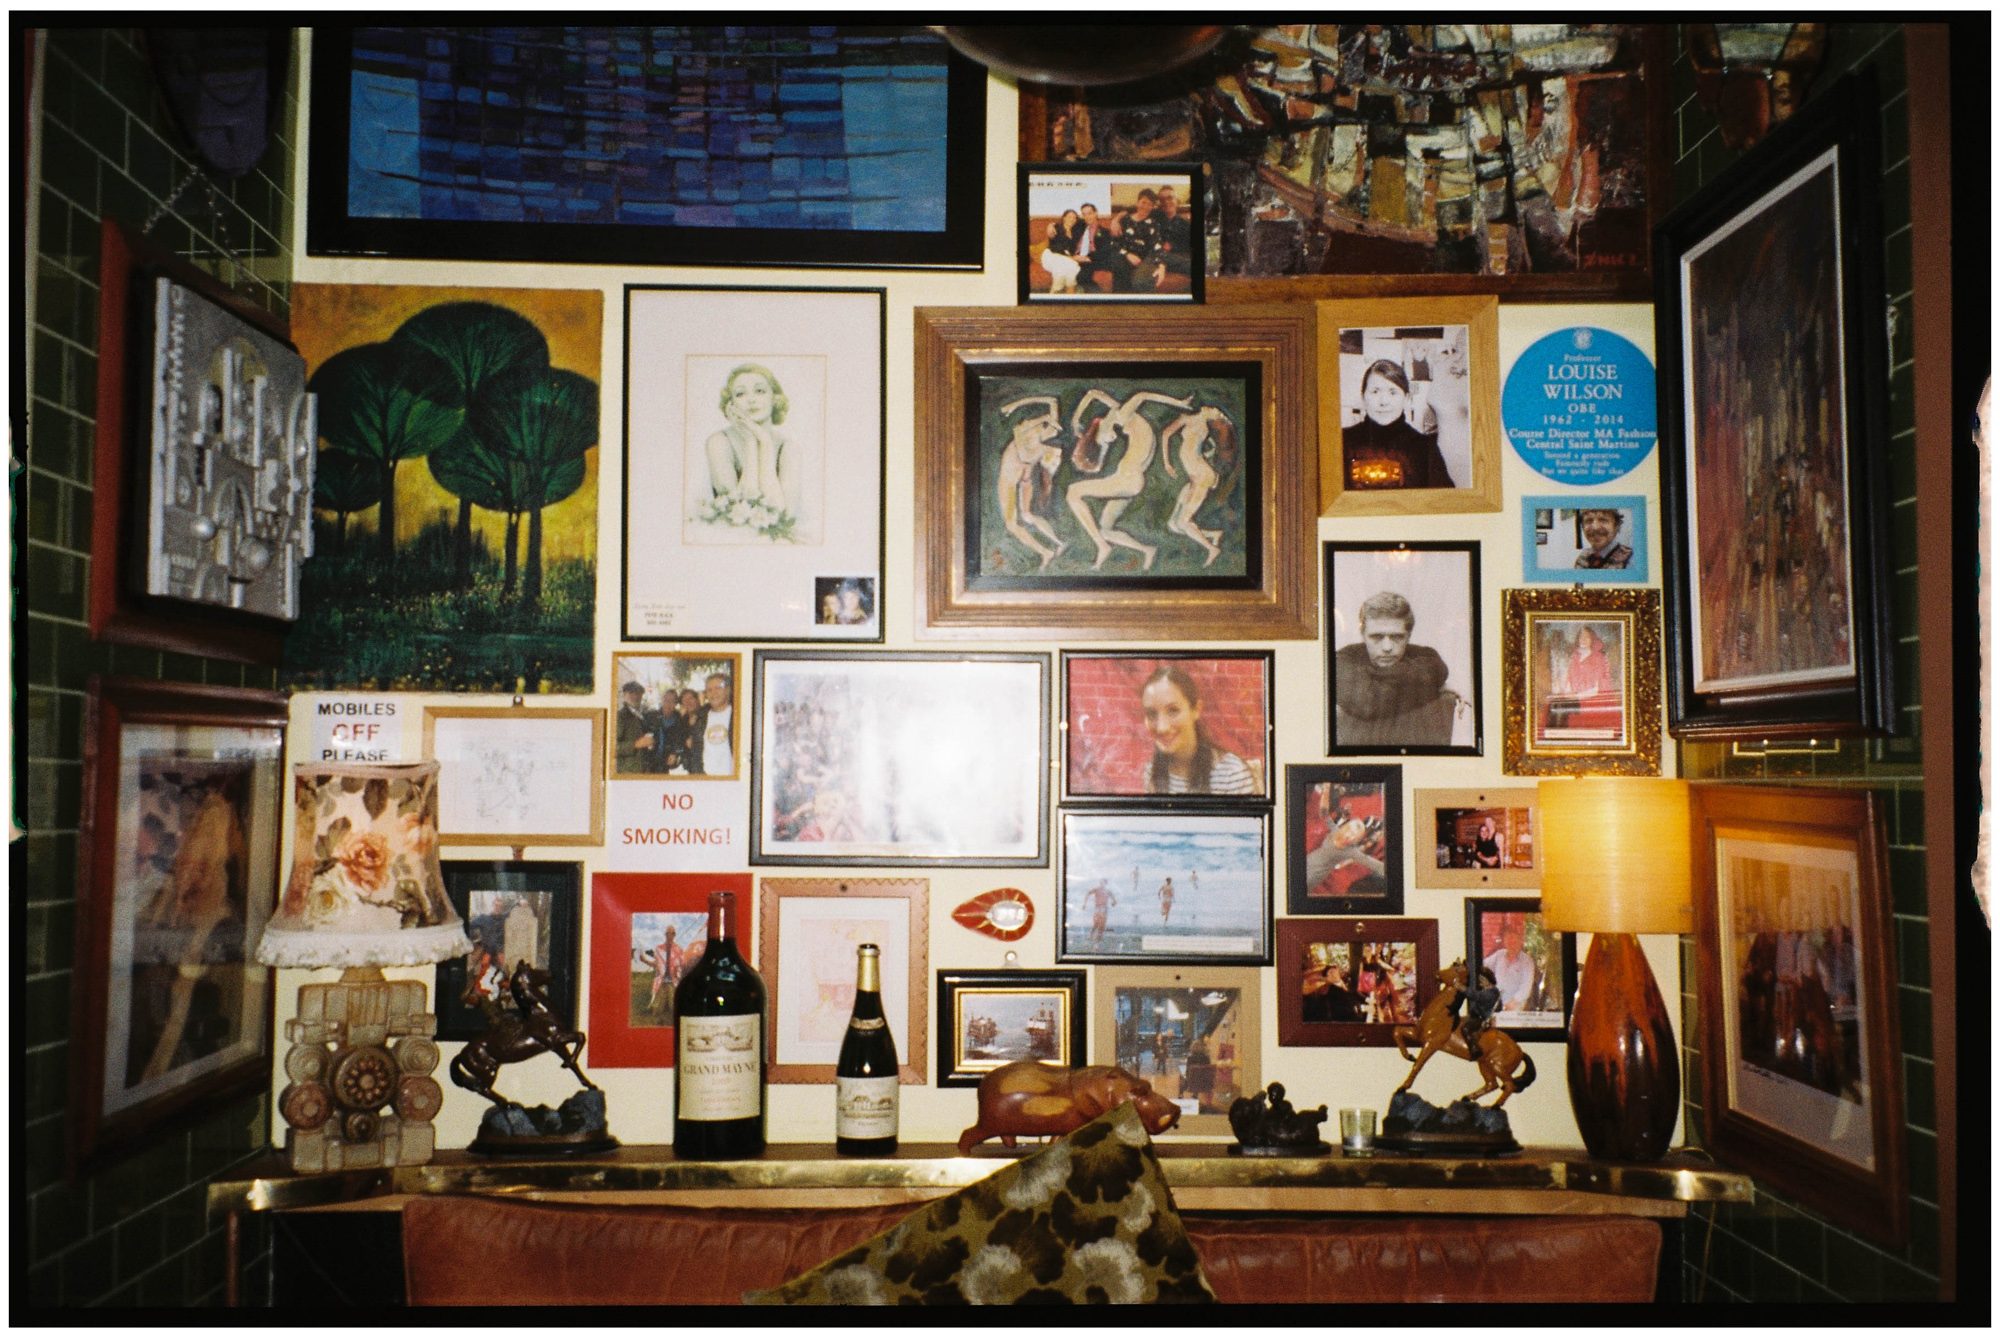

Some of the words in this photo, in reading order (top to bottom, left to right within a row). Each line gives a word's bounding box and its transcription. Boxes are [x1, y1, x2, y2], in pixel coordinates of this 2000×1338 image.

[1564, 354, 1601, 362] Professor
[1548, 364, 1618, 380] LOUISE
[1543, 384, 1623, 399] WILSON
[1568, 403, 1597, 413] OBE
[1543, 415, 1572, 424] 1962
[1594, 415, 1624, 424] 2014
[1509, 428, 1544, 438] Course
[1548, 428, 1590, 438] Director
[1594, 428, 1613, 438] MA
[1618, 428, 1657, 438] Fashion
[1526, 440, 1564, 449] Central
[1568, 440, 1594, 449] Saint
[1600, 440, 1640, 449] Martins
[318, 702, 396, 716] MOBILES
[332, 723, 381, 741] OFF
[322, 749, 388, 761] PLEASE
[662, 794, 694, 810] NO
[622, 828, 731, 845] SMOKING!
[683, 1064, 720, 1075] GRAND
[722, 1061, 756, 1074] MAYNE
